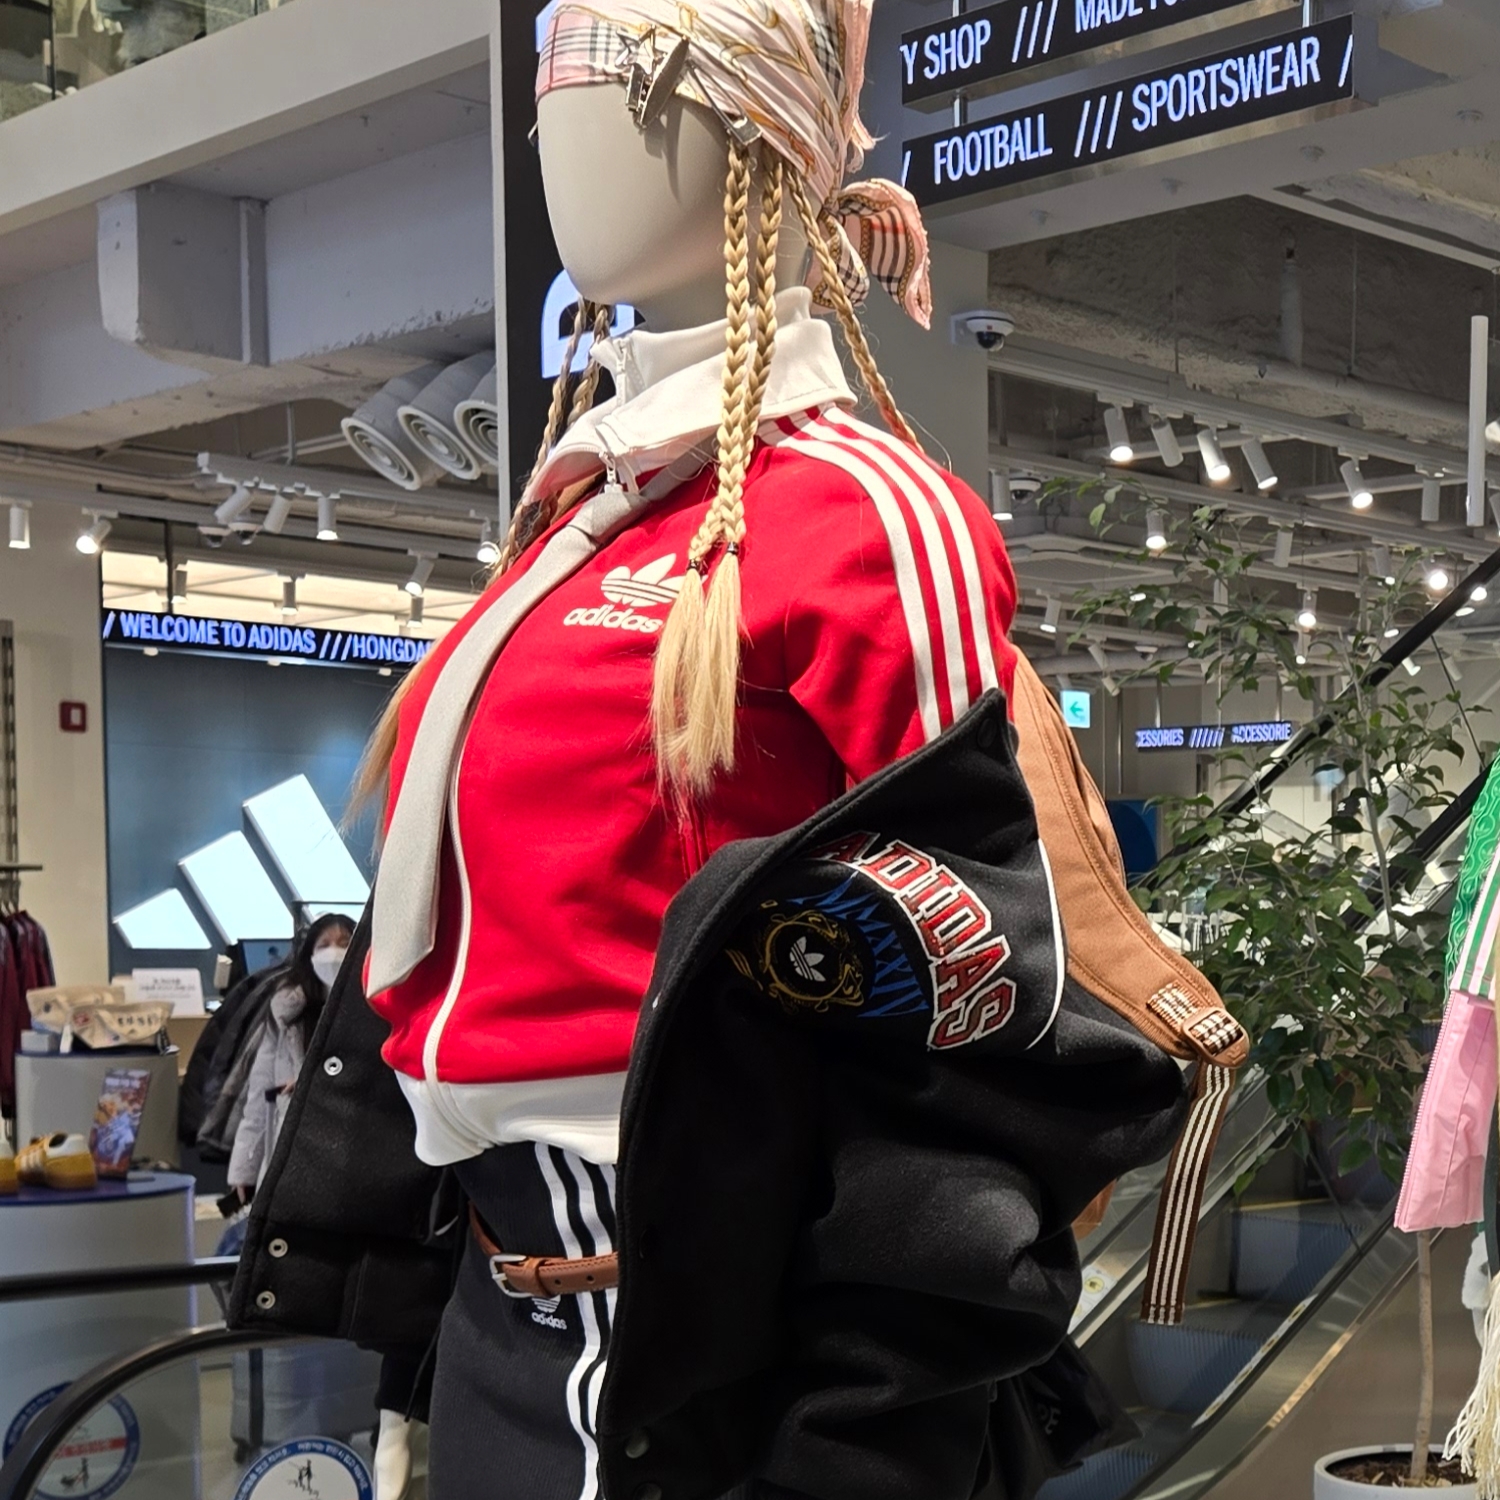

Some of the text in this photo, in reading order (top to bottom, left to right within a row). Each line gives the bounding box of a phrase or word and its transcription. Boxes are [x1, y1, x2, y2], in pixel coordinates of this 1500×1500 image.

[923, 19, 991, 79] SHOP
[934, 113, 1053, 184] FOOTBALL
[1132, 37, 1321, 132] SPORTSWEAR
[119, 612, 220, 645] WELCOME
[221, 621, 246, 647] TO
[249, 624, 316, 654] ADIDAS
[563, 604, 663, 633] adidas
[806, 829, 1018, 1051] ADIDAS
